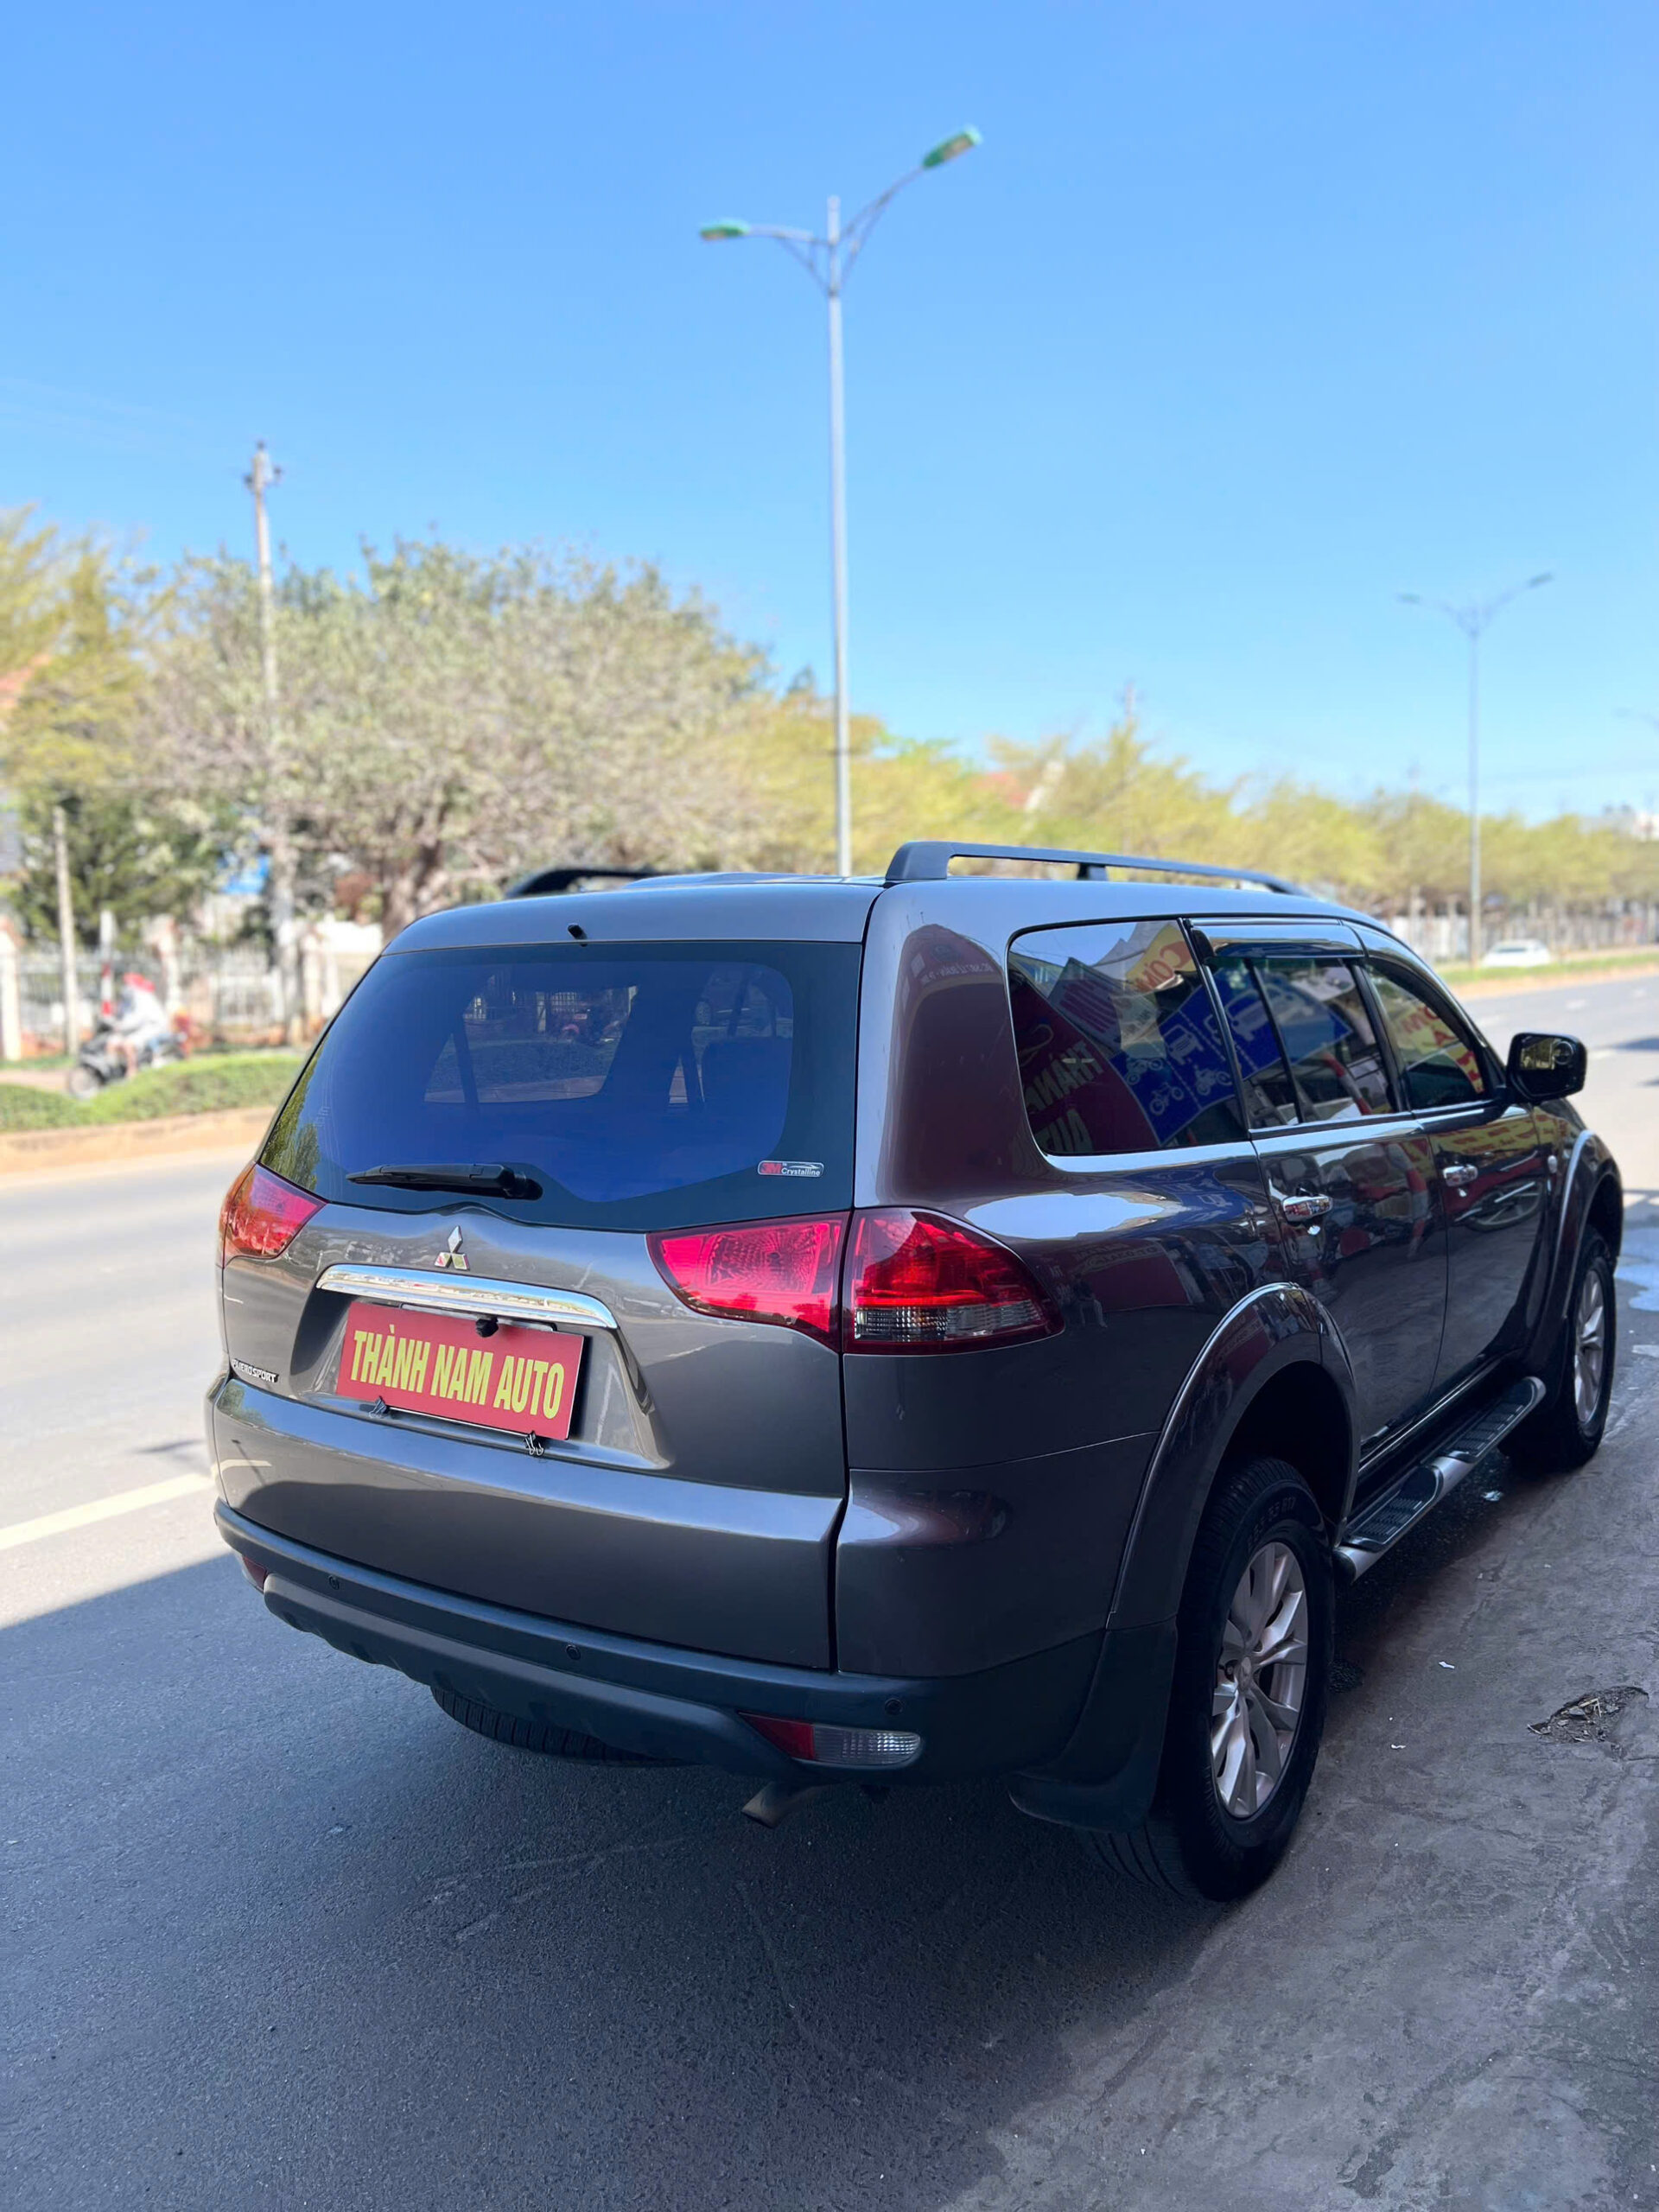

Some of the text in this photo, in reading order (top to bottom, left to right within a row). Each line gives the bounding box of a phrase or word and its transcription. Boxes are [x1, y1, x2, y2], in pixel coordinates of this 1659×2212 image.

[781, 1167, 821, 1176] Crystalline
[351, 1325, 564, 1419] THÀNH NAM AUTO
